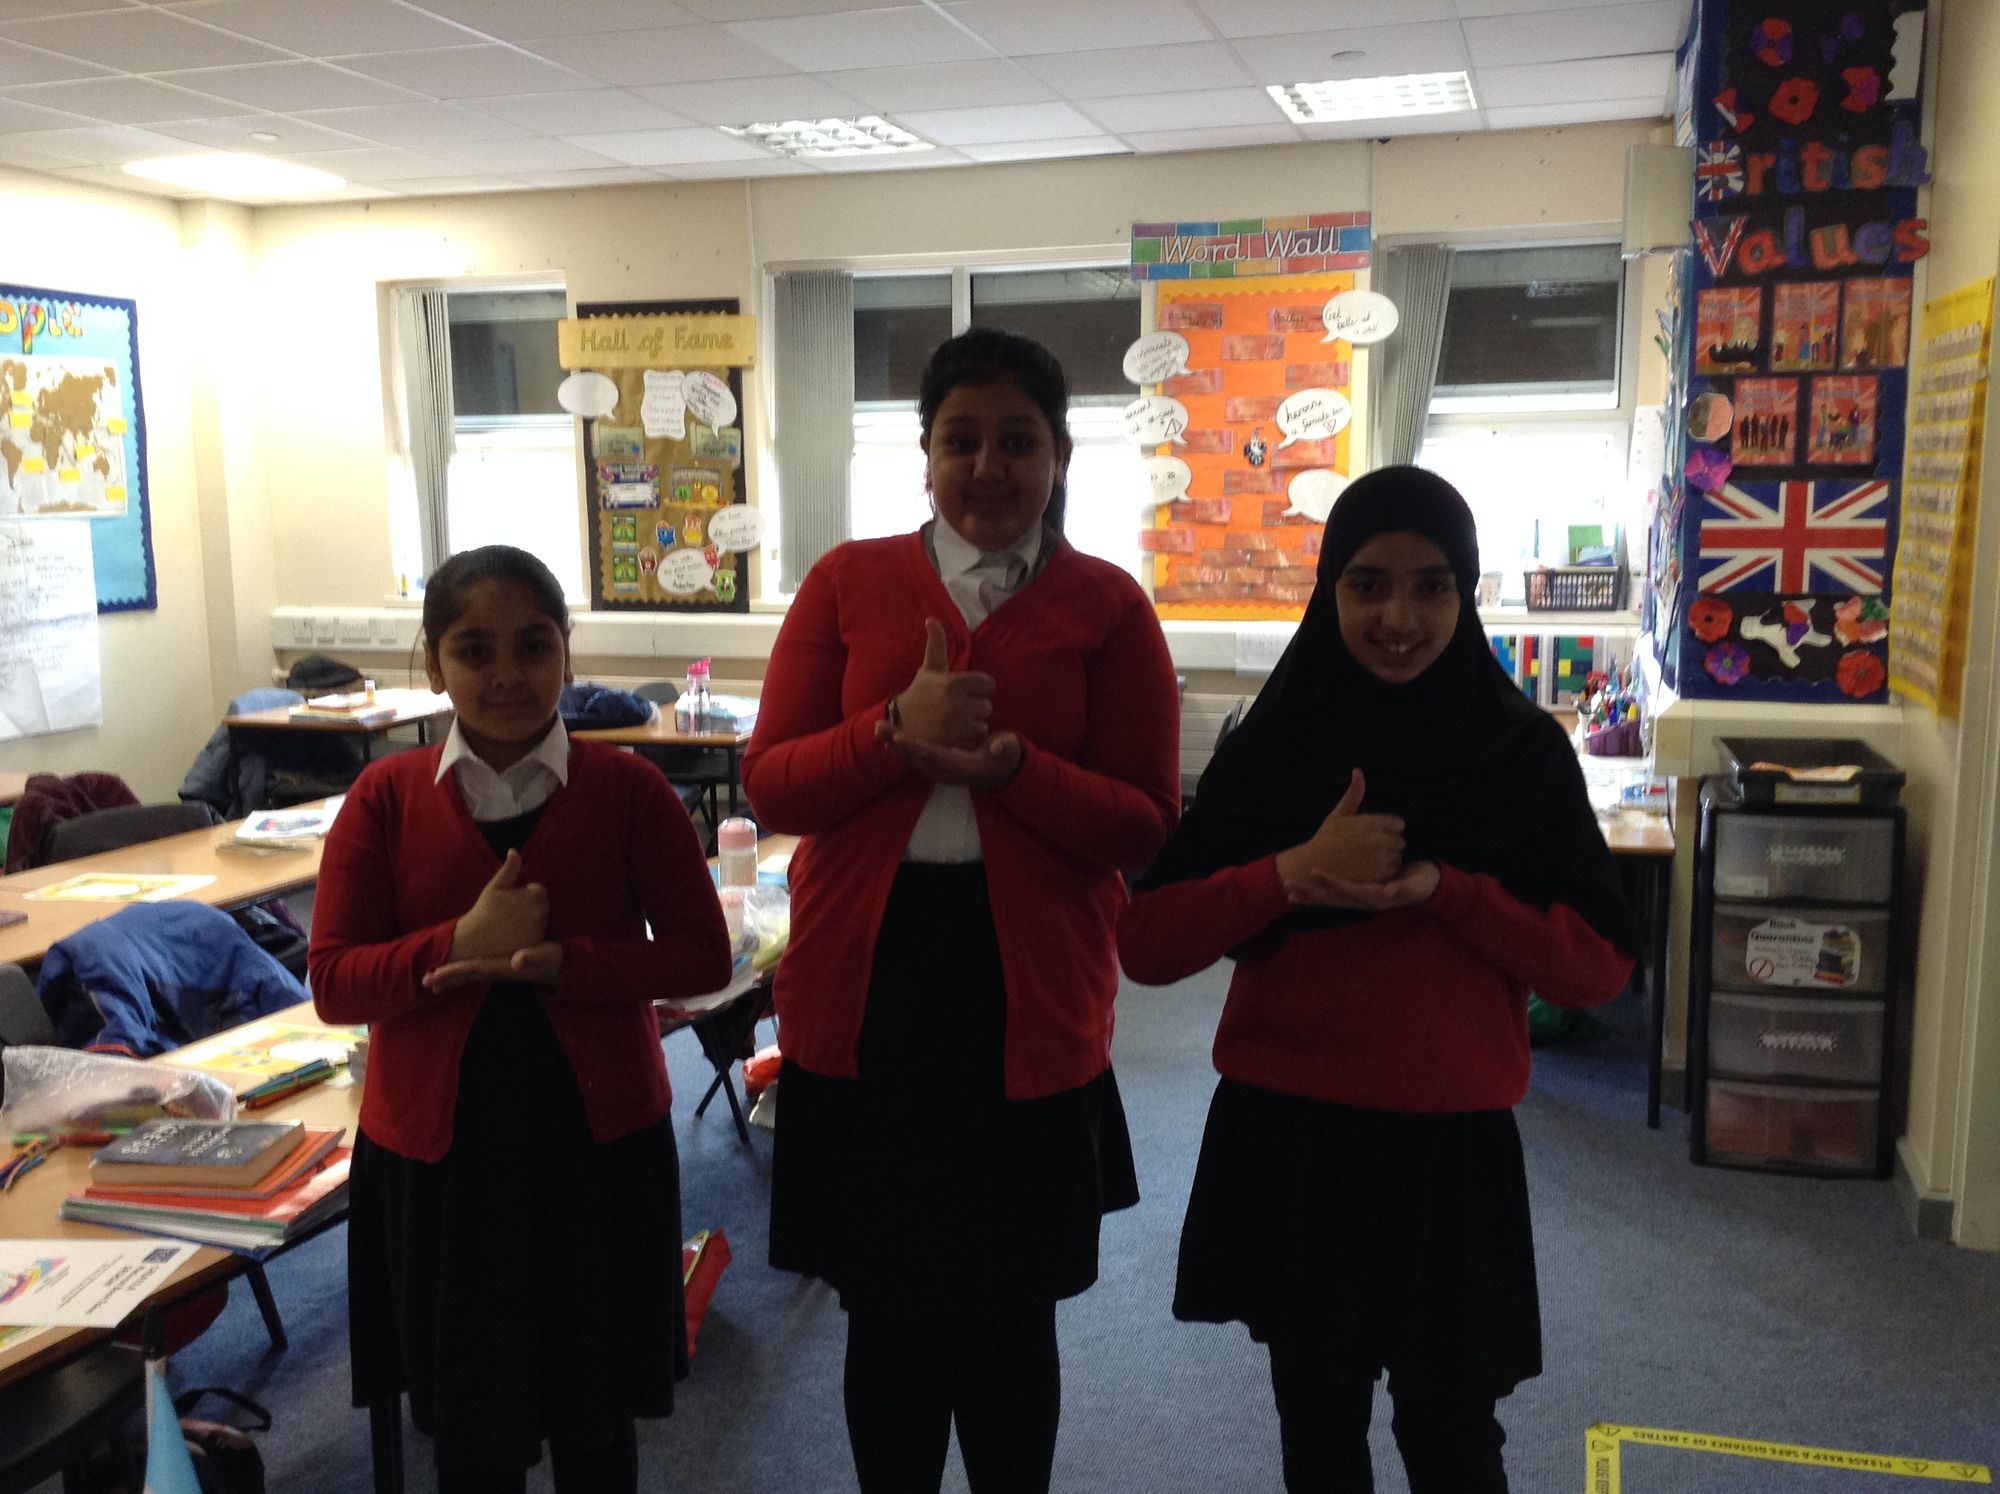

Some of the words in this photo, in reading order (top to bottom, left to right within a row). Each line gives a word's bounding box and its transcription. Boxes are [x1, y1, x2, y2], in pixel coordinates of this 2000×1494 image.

[1697, 120, 1931, 200] British
[1161, 232, 1245, 264] Word
[1263, 226, 1340, 258] Wall
[1690, 205, 1931, 276] Values
[580, 327, 629, 352] Hall
[637, 325, 665, 359] of
[674, 326, 733, 349] Fame
[1631, 1430, 1680, 1443] METRES
[1710, 1438, 1767, 1454] DISTANCE
[1769, 1446, 1799, 1458] SAFE
[1813, 1452, 1844, 1463] KEEP
[1846, 1455, 1892, 1469] PLEASE
